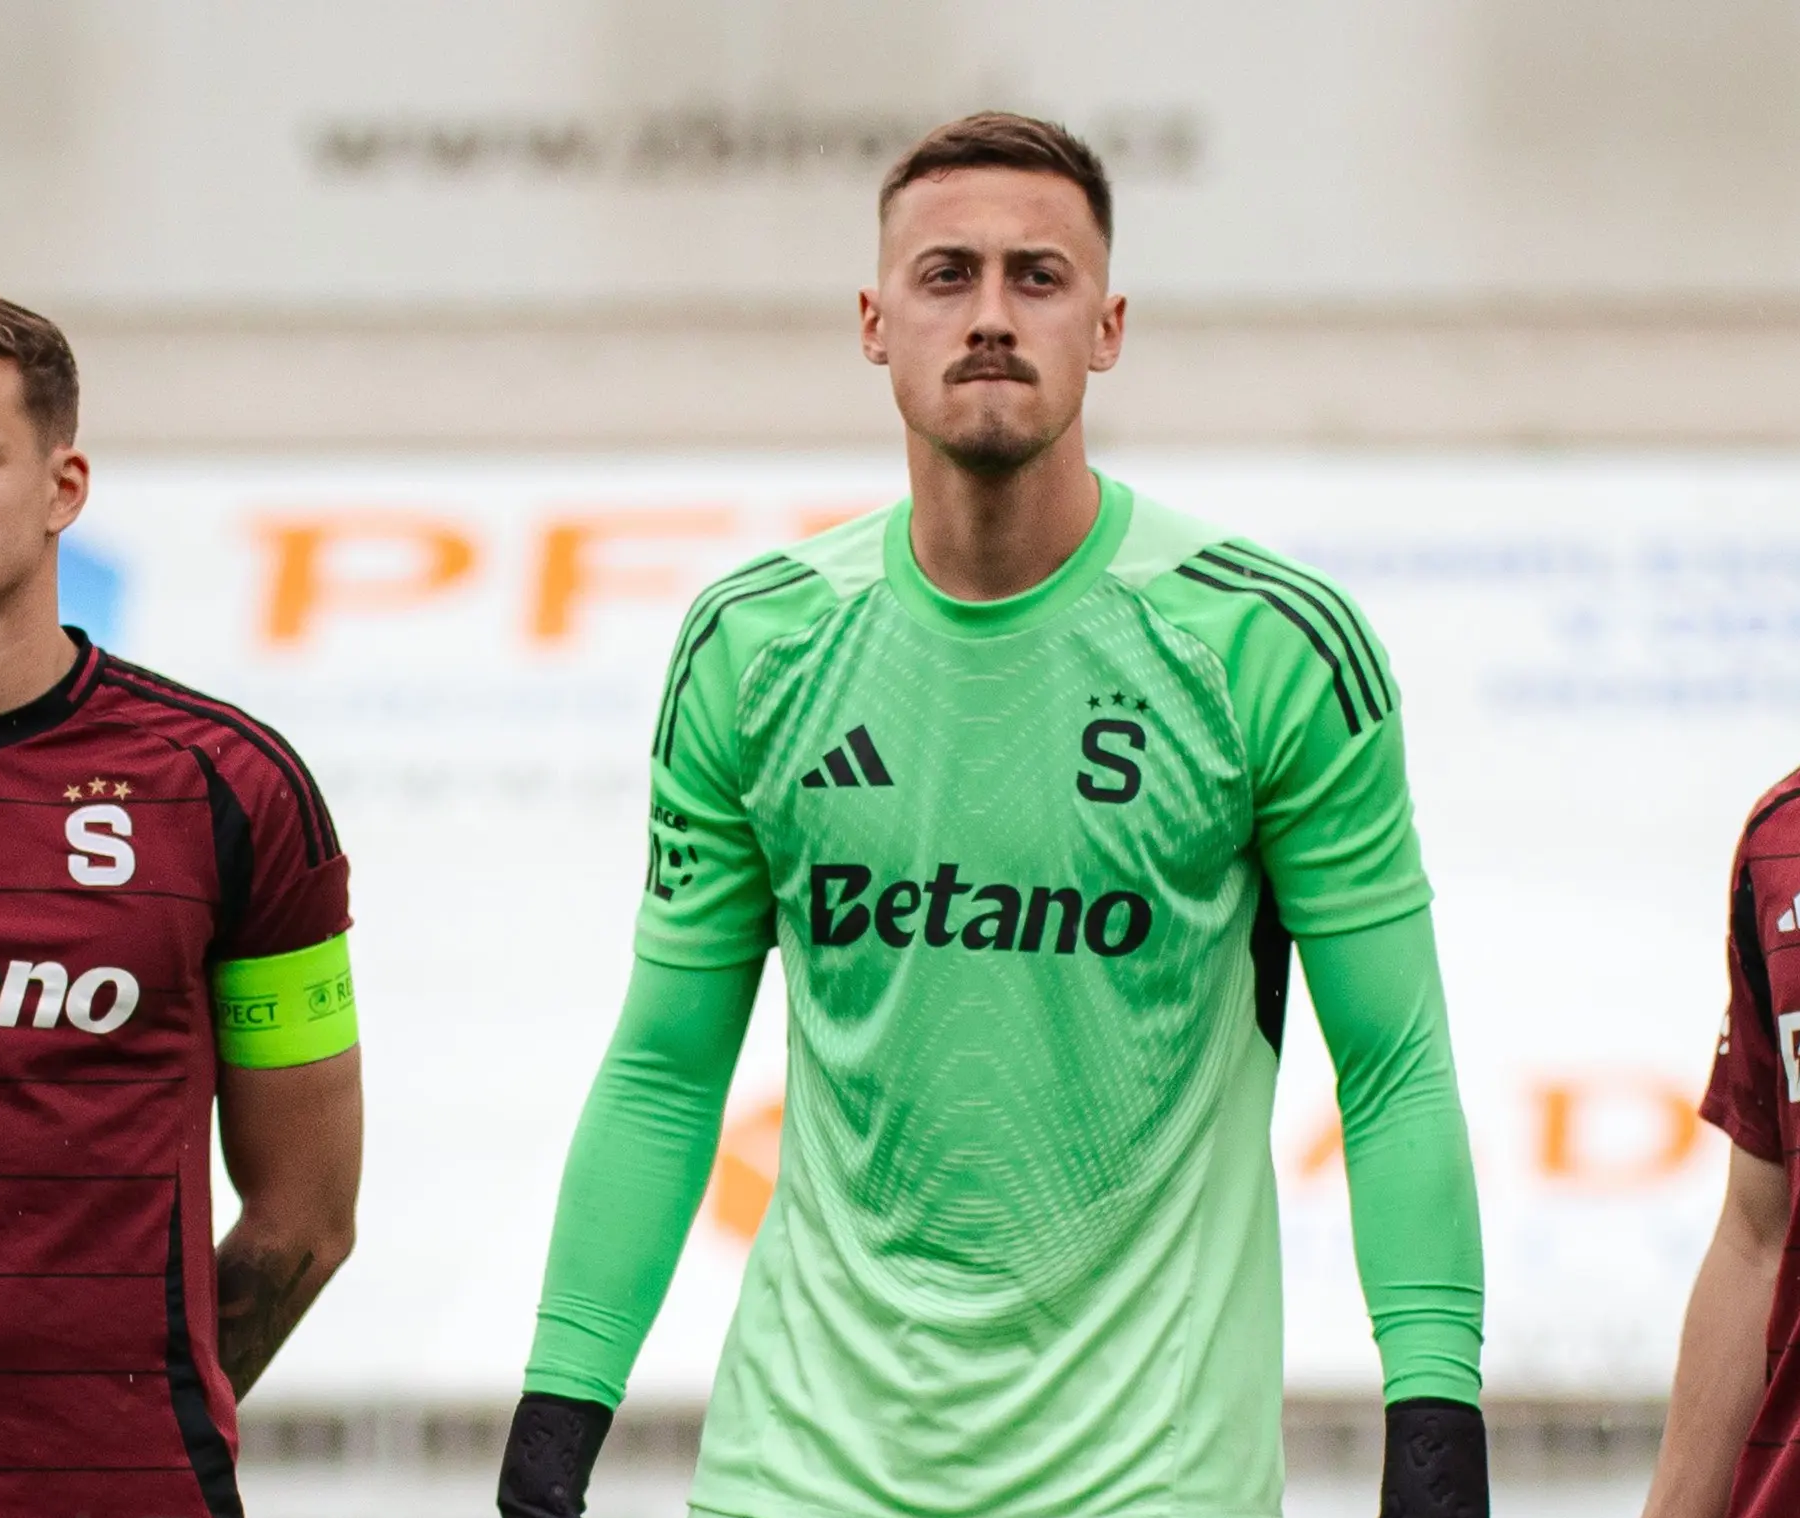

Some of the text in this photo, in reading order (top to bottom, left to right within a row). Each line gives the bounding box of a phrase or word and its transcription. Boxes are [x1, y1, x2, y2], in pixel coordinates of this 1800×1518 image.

[1076, 719, 1146, 804] S
[65, 804, 136, 887] S
[809, 862, 1153, 958] Betano
